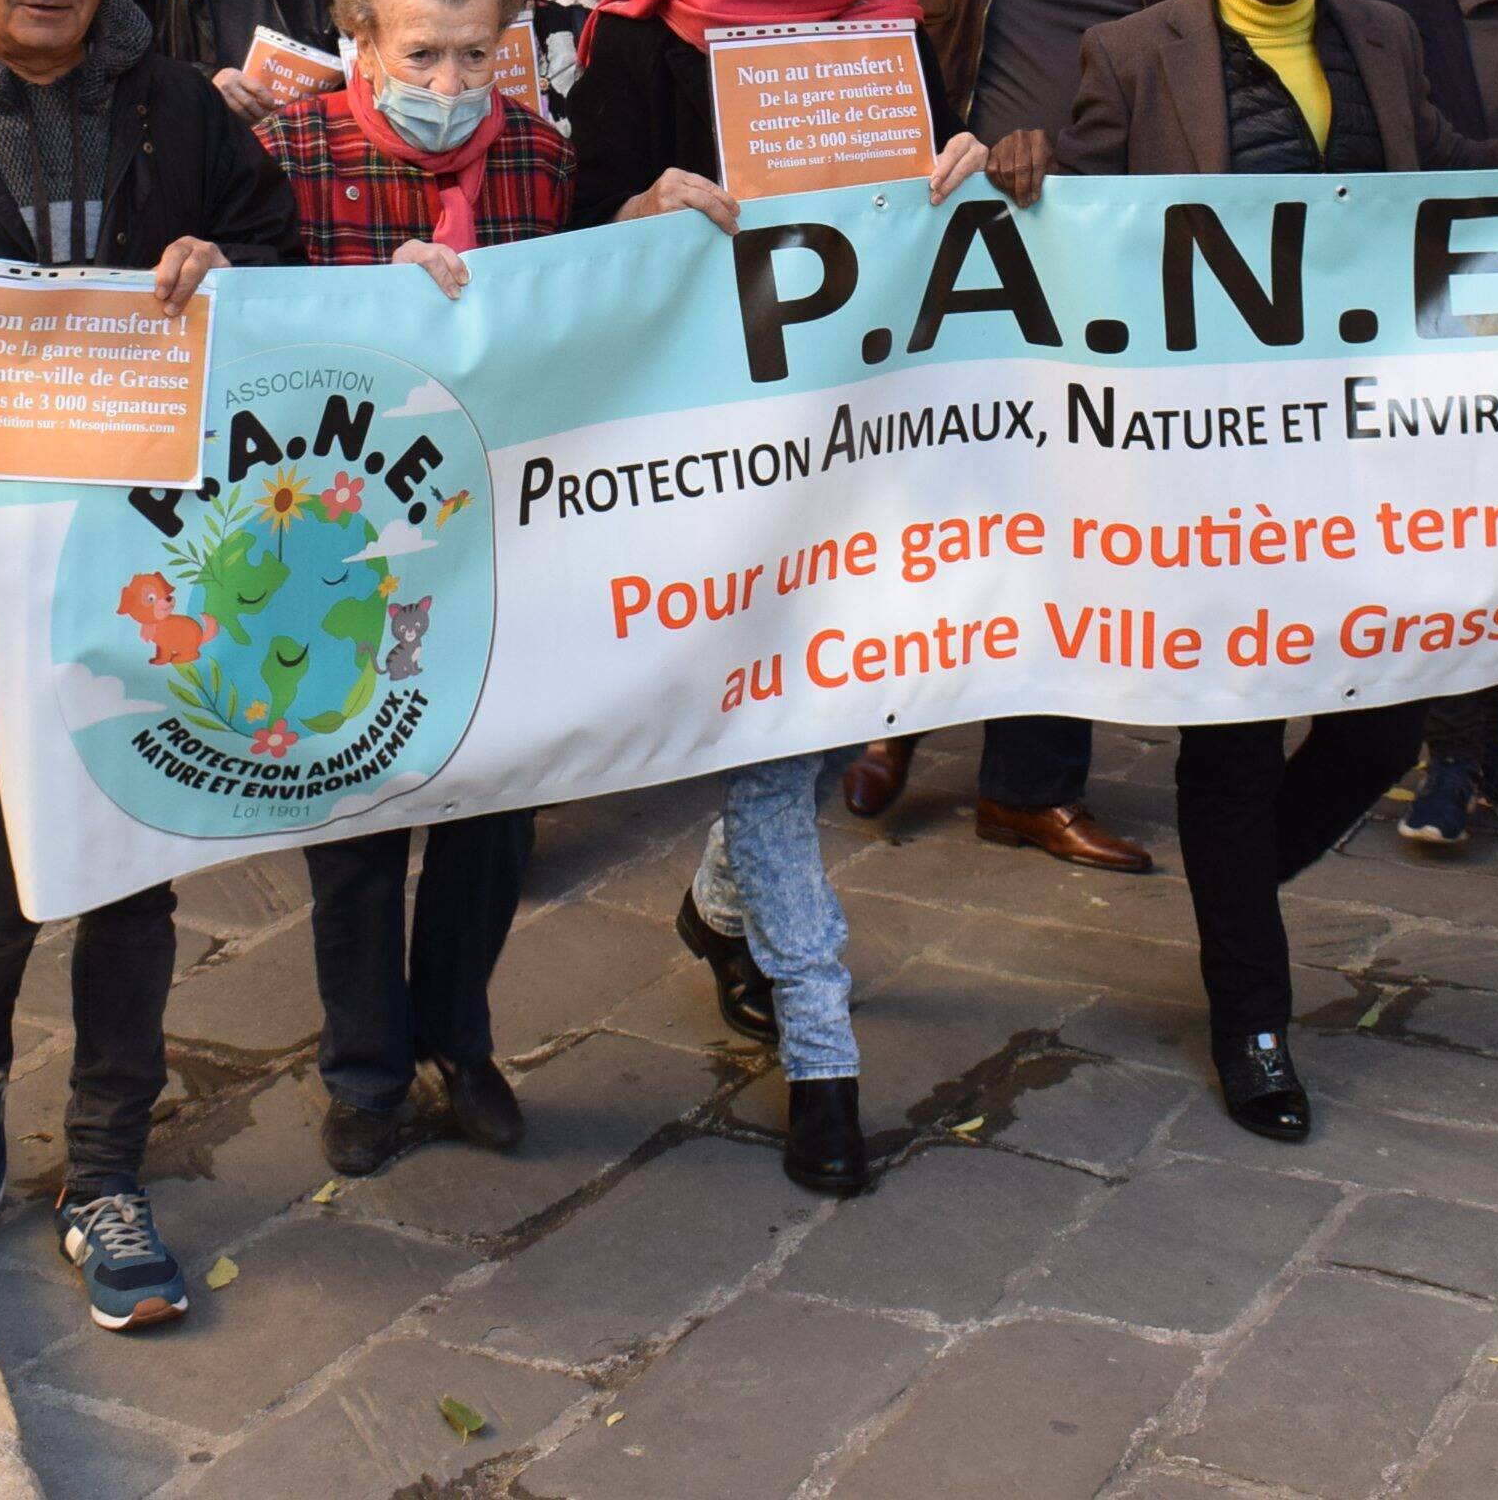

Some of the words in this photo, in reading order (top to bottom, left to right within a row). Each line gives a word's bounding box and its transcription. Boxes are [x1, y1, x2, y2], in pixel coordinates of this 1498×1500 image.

[262, 56, 294, 80] Non
[296, 73, 316, 88] au
[509, 63, 526, 78] du
[736, 65, 781, 87] Non
[785, 65, 810, 82] au
[814, 55, 895, 80] transfert
[898, 55, 905, 73] !
[271, 79, 289, 94] De
[759, 92, 781, 108] De
[784, 89, 798, 106] la
[801, 88, 835, 108] gare
[839, 82, 893, 101] routière
[895, 80, 913, 96] du
[749, 108, 841, 132] centre-ville
[844, 106, 864, 123] de
[867, 104, 918, 121] Grasse
[748, 138, 782, 156] Plus
[785, 136, 803, 152] de
[807, 134, 817, 150] 3
[820, 131, 847, 148] 000
[850, 125, 923, 147] signatures
[767, 156, 807, 170] Pétition
[808, 155, 826, 166] sur
[833, 146, 918, 164] Mesopinions.com
[29, 313, 58, 332] au
[64, 312, 172, 336] transfert
[179, 315, 188, 337] !
[21, 340, 38, 358] la
[41, 344, 83, 361] gare
[88, 343, 162, 363] routière
[166, 345, 192, 364] du
[89, 367, 114, 388] de
[119, 369, 190, 391] Grasse
[224, 368, 375, 409] ASSOCIATION
[12, 391, 35, 411] de
[38, 393, 50, 411] 3
[54, 394, 88, 413] 000
[92, 396, 188, 418] signatures
[36, 418, 58, 430] sur
[68, 417, 176, 434] Mesopinions.com
[518, 436, 811, 527] PROTECTION
[821, 402, 1048, 472] ANIMAUX,
[1066, 382, 1268, 451] NATURE
[1281, 402, 1328, 444] ET
[610, 563, 763, 640] Pour
[776, 531, 878, 597] une
[901, 512, 1045, 583] gare
[1072, 503, 1357, 568] routière
[719, 652, 784, 715] au
[805, 614, 1020, 689] Centre
[1043, 602, 1202, 670] Ville
[1226, 608, 1315, 668] de
[130, 728, 207, 792] NATURE
[208, 774, 240, 797] ET
[241, 688, 430, 801] ENVIRONNEMENT
[156, 716, 301, 782] PROTECTION
[306, 688, 413, 781] ANIMAUX,
[231, 802, 261, 821] Loi
[267, 803, 312, 820] 1901
